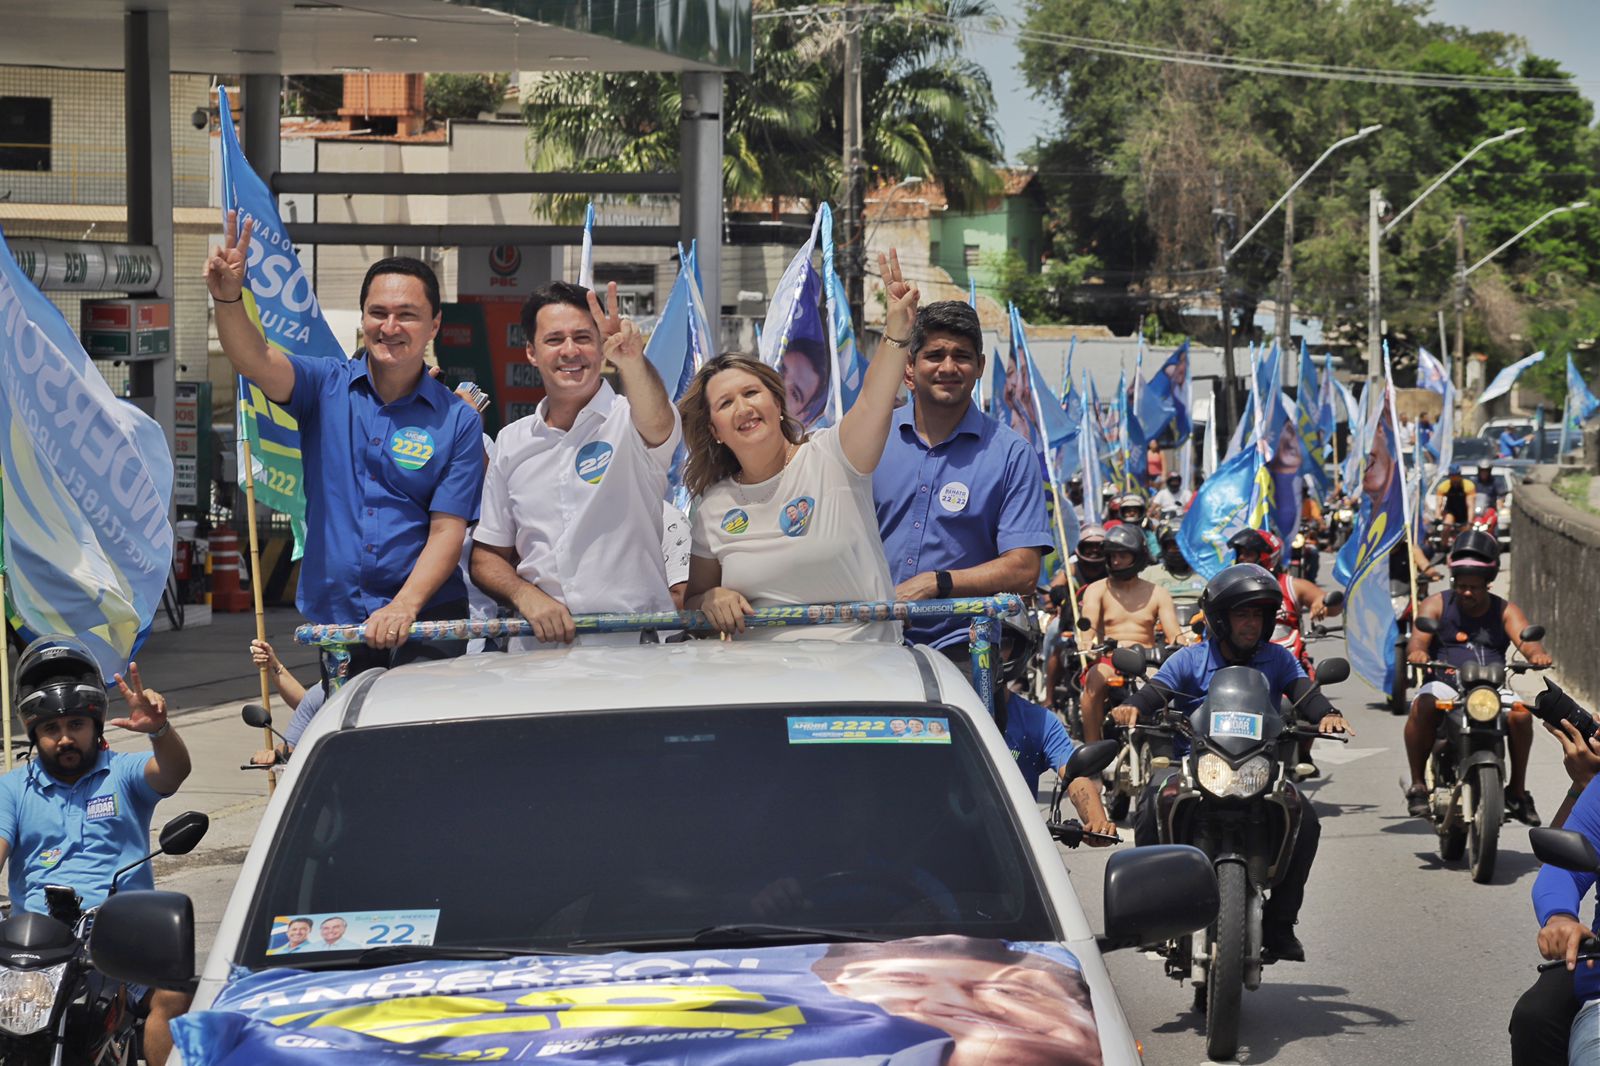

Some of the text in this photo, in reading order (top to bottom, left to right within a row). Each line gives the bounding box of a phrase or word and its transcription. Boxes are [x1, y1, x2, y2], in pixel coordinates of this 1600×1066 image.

[63, 252, 88, 284] BEM
[115, 254, 153, 285] VINDOS
[256, 304, 311, 344] UIZA
[392, 437, 433, 461] 2222
[579, 450, 612, 476] 22
[268, 466, 296, 496] 222
[911, 601, 985, 614] ANDERSON 22
[830, 720, 885, 731] 2222
[87, 801, 114, 815] MUDAR
[367, 923, 416, 945] 22
[239, 957, 760, 1010] ANDERSON
[535, 1029, 735, 1058] BOLSONARO
[734, 1027, 795, 1041] 22
